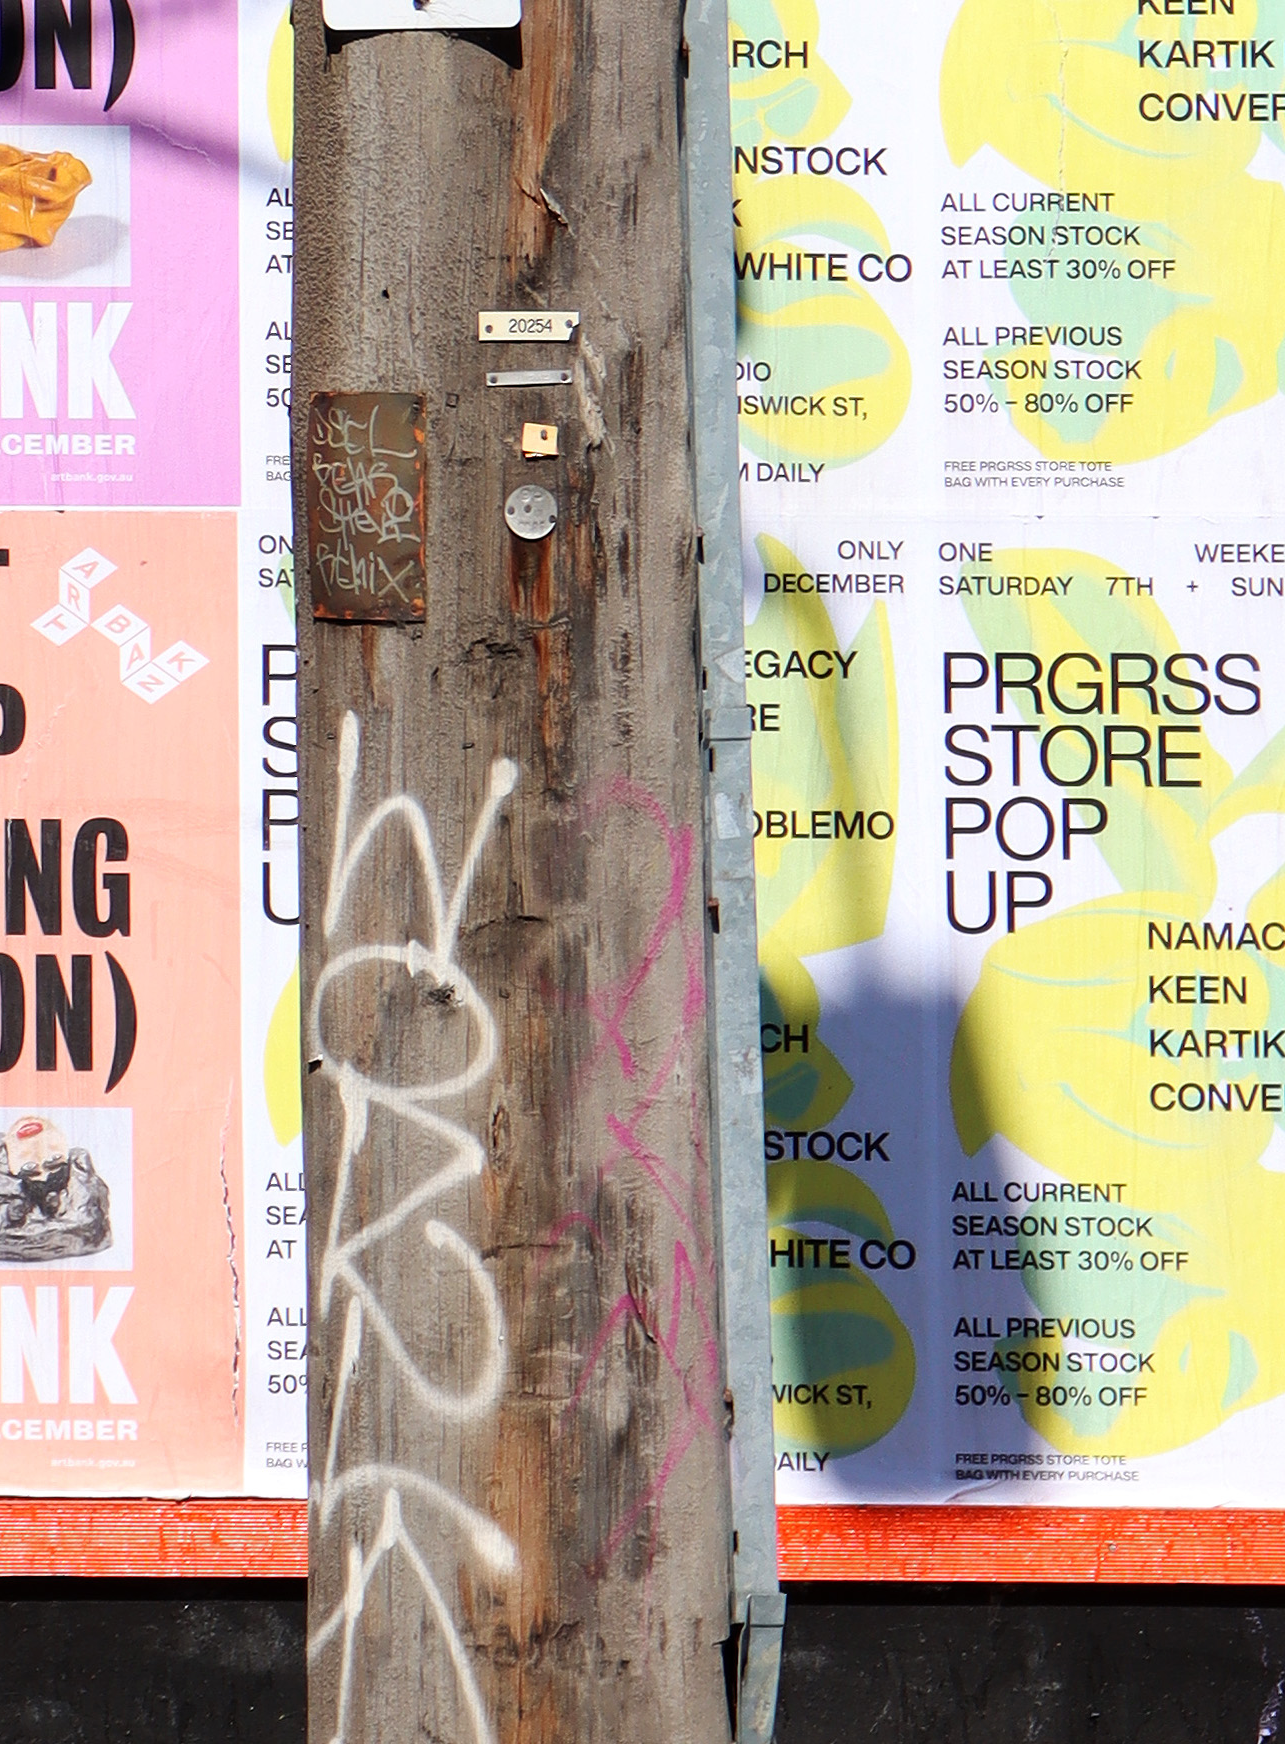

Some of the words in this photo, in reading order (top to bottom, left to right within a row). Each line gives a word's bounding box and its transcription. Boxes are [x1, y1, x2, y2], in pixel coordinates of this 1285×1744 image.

[1139, 41, 1274, 68] KARTIK
[735, 146, 887, 175] NSTOCK
[941, 193, 986, 212] ALL
[994, 193, 1114, 212] CURRENT
[942, 226, 1044, 245] SEASON
[1052, 226, 1140, 245] STOCK
[734, 253, 848, 282] WHITE
[859, 254, 911, 282] CO
[942, 260, 972, 278] AT
[981, 259, 1060, 279] LEAST
[1067, 259, 1120, 279] 30%
[1128, 260, 1175, 279] OFF
[509, 319, 552, 333] 20254
[943, 327, 988, 345] ALL
[997, 327, 1122, 346] PREVIOUS
[944, 360, 1046, 379] SEASON
[1054, 360, 1141, 379] STOCK
[744, 396, 825, 415] SWICK
[833, 397, 866, 420] ST,
[945, 394, 998, 413] 50%
[1025, 393, 1078, 413] 80%
[1085, 394, 1133, 413] OFF
[758, 463, 825, 482] DAILY
[945, 461, 976, 471] FREE
[980, 461, 1032, 471] PRGRSS
[1036, 461, 1075, 471] STORE
[1079, 461, 1112, 471] TOTE
[51, 472, 133, 483] artbank.gov.au
[945, 477, 971, 487] BAG
[975, 477, 1008, 487] WITH
[1012, 477, 1050, 487] EVERY
[1055, 477, 1125, 487] PURCHASE
[839, 540, 903, 560] ONLY
[940, 542, 992, 562] ONE
[764, 573, 903, 594] DECEMBER
[940, 576, 1073, 595] SATURDAY
[1106, 577, 1152, 596] 7TH
[945, 652, 1260, 715] PRGRSS
[946, 725, 1201, 787] STORE
[946, 796, 1107, 861] POP
[947, 871, 1052, 934] UP
[1149, 922, 1285, 951] NAMAC
[1149, 976, 1246, 1004] KEEN
[1150, 1029, 1285, 1058] KARTIK
[1150, 1083, 1282, 1112] CONVE
[952, 1182, 998, 1202] ALL
[1004, 1183, 1126, 1203] CURRENT
[953, 1215, 1056, 1236] SEASON
[1065, 1217, 1152, 1237] STOCK
[267, 1240, 297, 1258] AT
[770, 1240, 849, 1268] HITE
[860, 1240, 916, 1269] CO
[953, 1250, 984, 1269] AT
[991, 1250, 1070, 1270] LEAST
[1078, 1251, 1133, 1271] 30%
[1140, 1251, 1188, 1271] OFF
[954, 1317, 1001, 1337] ALL
[1007, 1318, 1135, 1338] PREVIOUS
[954, 1352, 1060, 1372] SEASON
[1067, 1353, 1154, 1373] STOCK
[837, 1385, 871, 1409] ST,
[955, 1386, 1010, 1406] 50%
[1036, 1386, 1091, 1407] 80%
[1099, 1387, 1146, 1406] OFF
[956, 1454, 988, 1464] FREE
[991, 1454, 1043, 1465] PRGRSS
[1047, 1455, 1089, 1465] STORE
[1093, 1456, 1126, 1465] TOTE
[956, 1470, 983, 1479] BAG
[987, 1470, 1020, 1480] WITH
[1022, 1471, 1064, 1480] EVERY
[1069, 1471, 1139, 1481] PURCHASE
